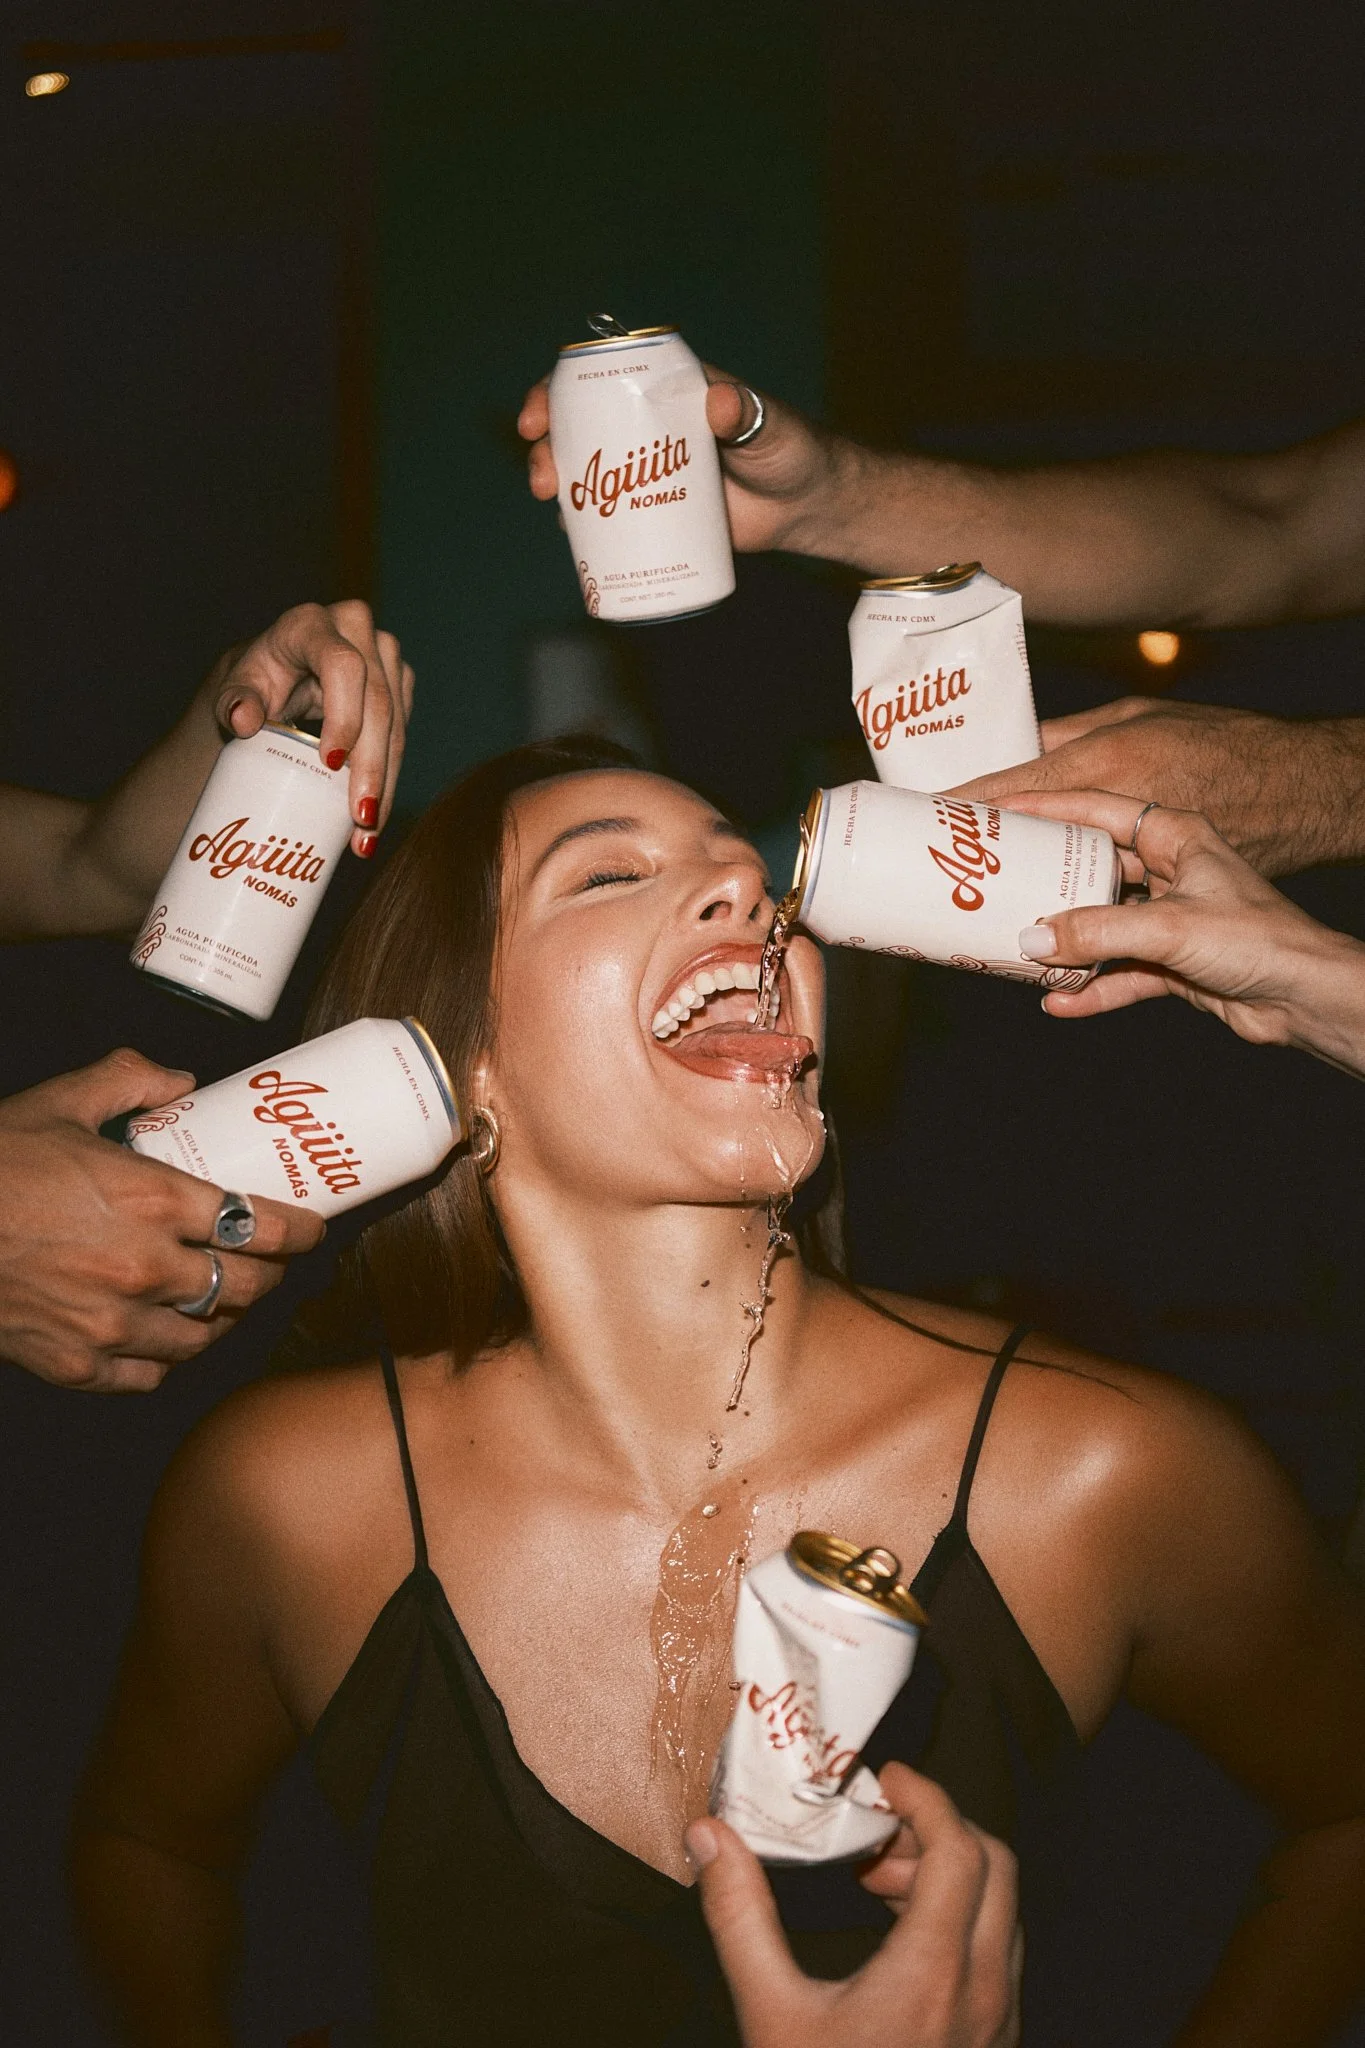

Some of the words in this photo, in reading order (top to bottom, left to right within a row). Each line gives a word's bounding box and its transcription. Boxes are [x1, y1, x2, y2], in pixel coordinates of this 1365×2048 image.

[577, 371, 605, 380] HECHA
[608, 369, 620, 377] EN
[623, 364, 649, 374] CDMX
[571, 434, 691, 518] Agüita
[630, 485, 687, 510] NOMÁS
[604, 573, 627, 582] AGUA
[630, 563, 689, 579] PURIFICADA
[867, 613, 892, 621] HECHA
[911, 615, 936, 623] CDMX
[905, 714, 965, 738] NOMÁS
[266, 747, 293, 760] HECHA
[296, 758, 307, 767] EN
[849, 803, 857, 814] EN
[844, 816, 855, 846] HECHA
[189, 817, 326, 883] Agüita
[243, 875, 298, 908] NOMÁS
[1060, 870, 1071, 899] AGUA
[1069, 858, 1081, 907] ARBONATADA
[175, 926, 199, 941] AGUA
[203, 936, 259, 967] PURIFICADA
[392, 1046, 411, 1075] HECHA
[409, 1077, 419, 1090] EN
[416, 1093, 431, 1121] CDMX
[181, 1129, 199, 1154] AGUA
[248, 1070, 362, 1194] Agüita
[272, 1138, 309, 1199] NOMÁS
